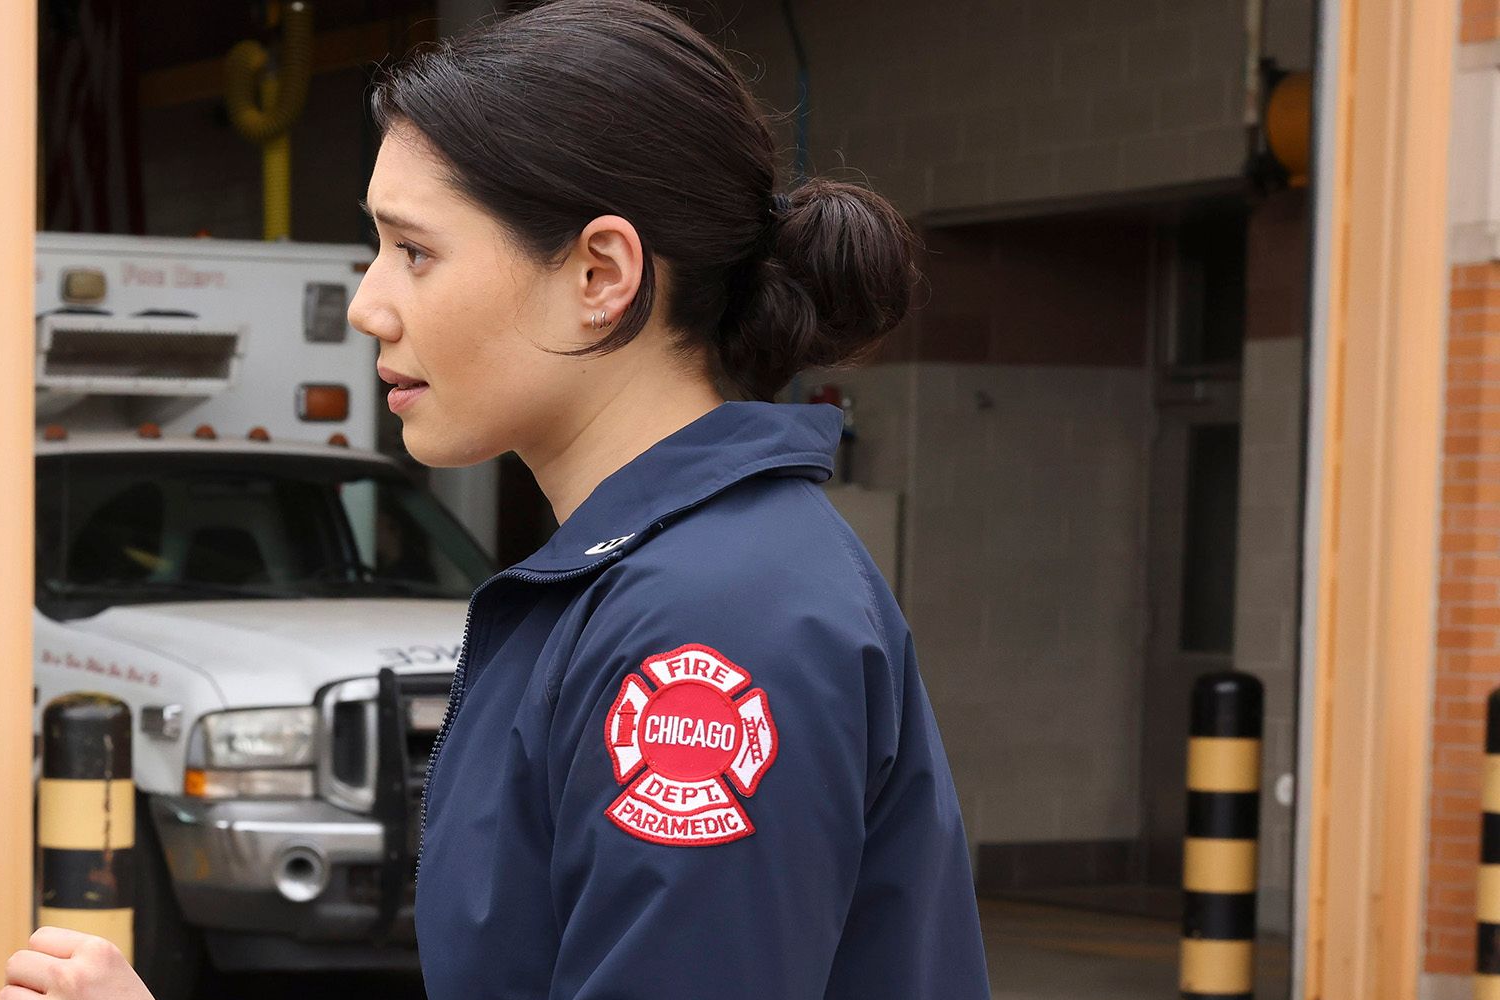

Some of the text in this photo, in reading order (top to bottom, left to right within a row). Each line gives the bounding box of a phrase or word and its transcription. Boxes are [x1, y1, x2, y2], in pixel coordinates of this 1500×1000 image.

[666, 657, 730, 684] FIRE
[644, 715, 736, 751] CHICAGO
[644, 778, 720, 804] DEPT.
[618, 801, 739, 836] PARAMEDIC
